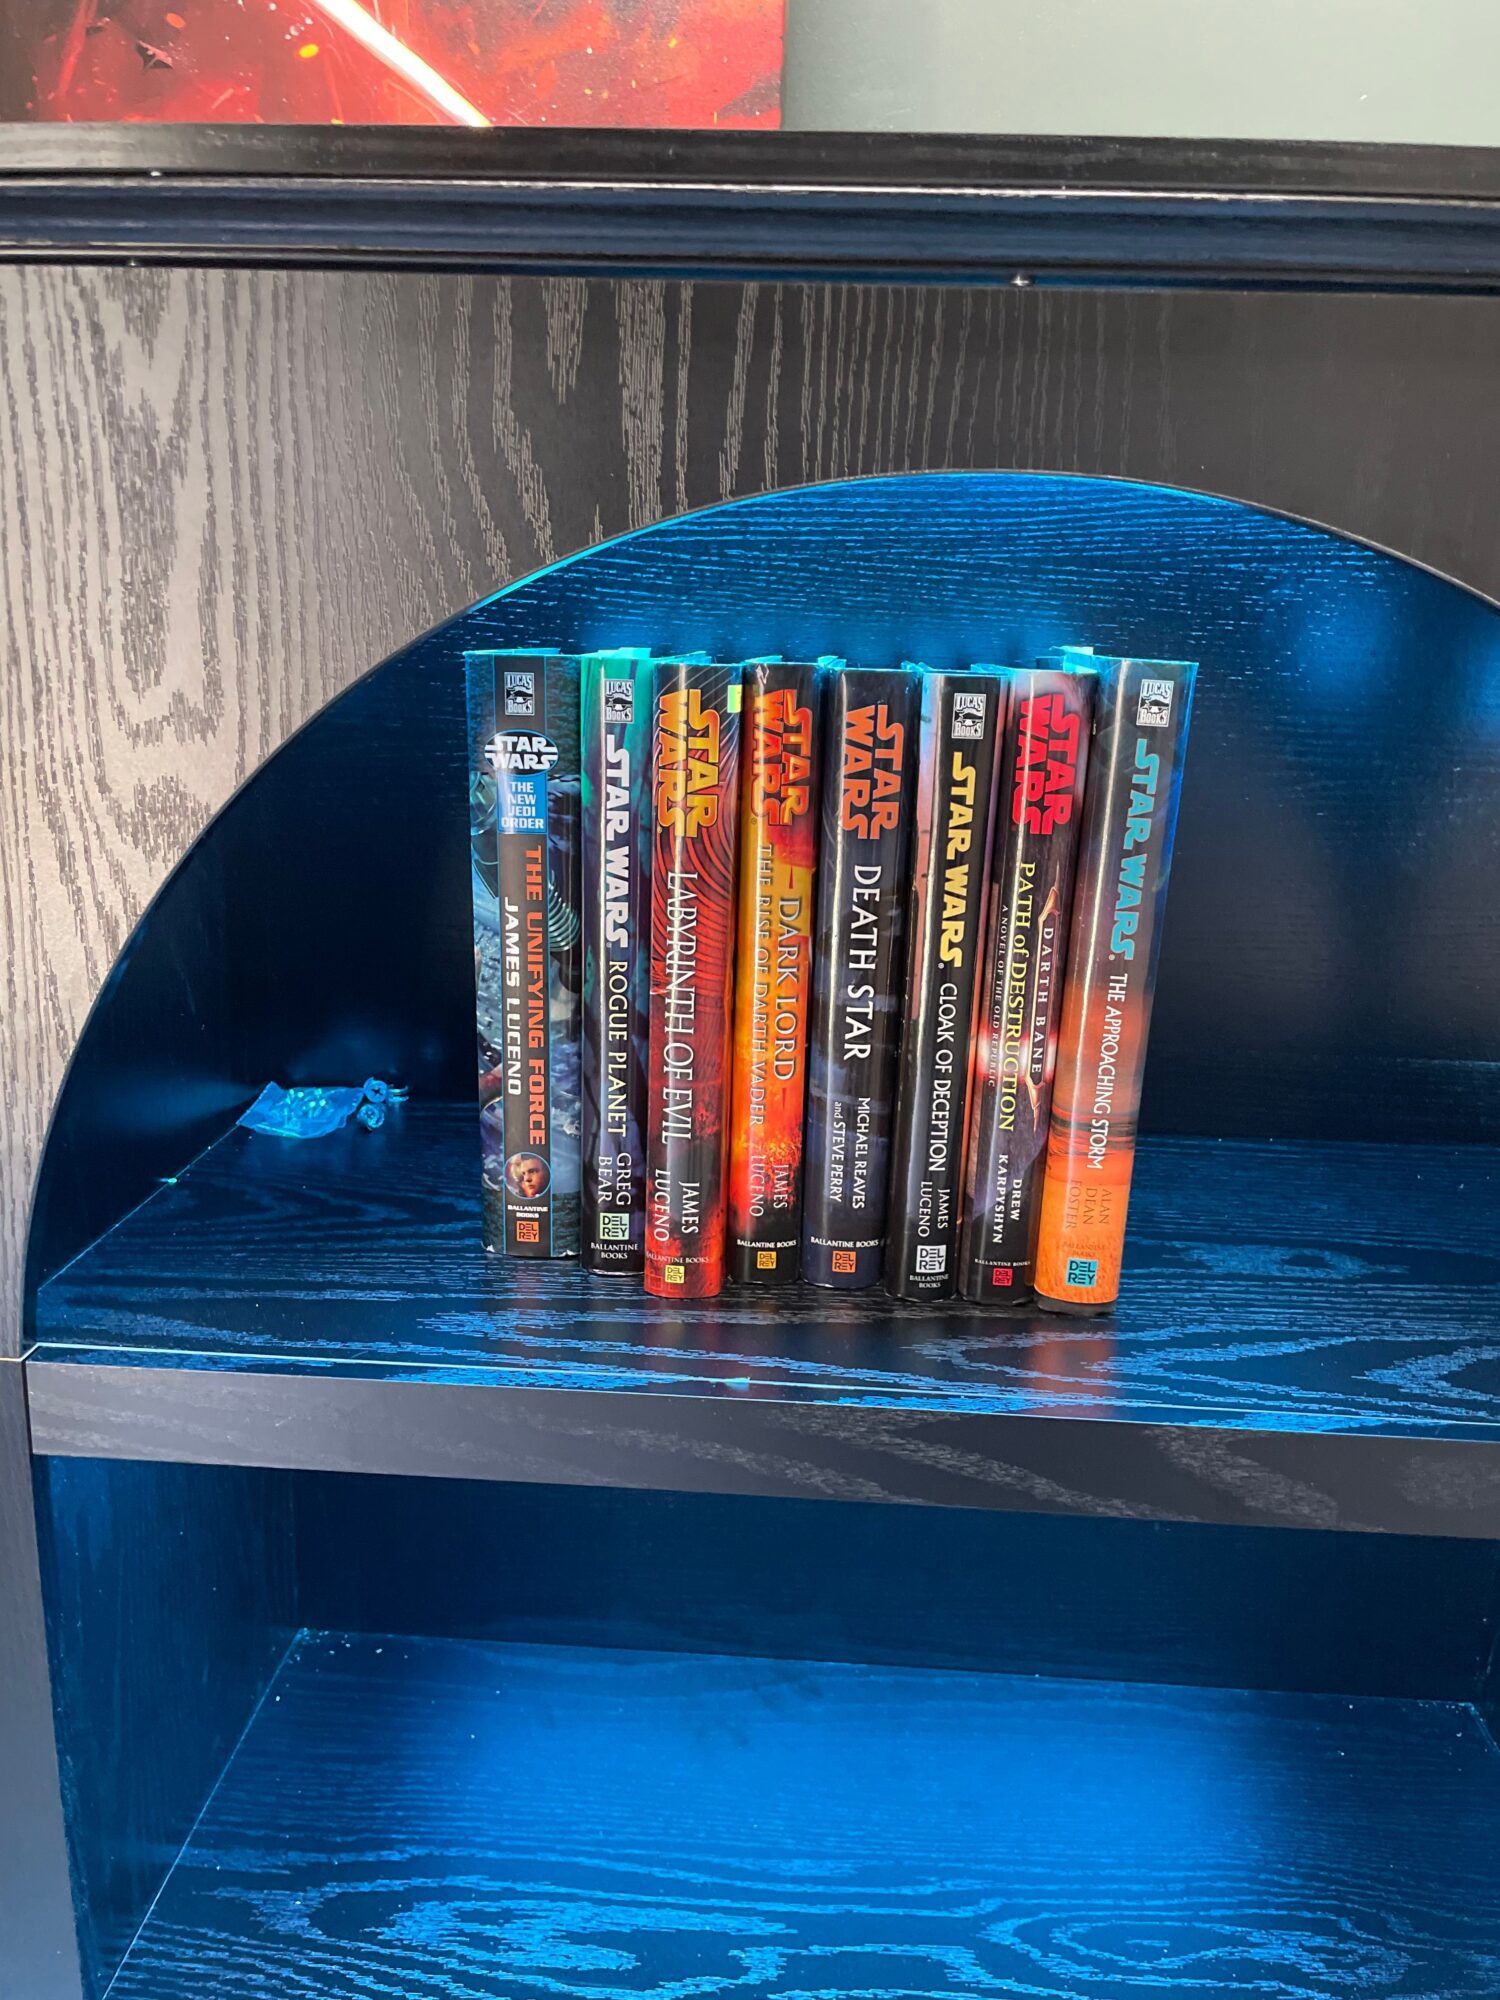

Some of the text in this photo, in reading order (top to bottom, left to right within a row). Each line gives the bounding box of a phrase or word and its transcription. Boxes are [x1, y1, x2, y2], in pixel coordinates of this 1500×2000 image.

[507, 674, 532, 690] LUCAS
[606, 680, 632, 695] LUCAS
[1142, 682, 1171, 698] LUCAS
[507, 702, 533, 713] BOOKS
[606, 707, 632, 720] BOOKS
[956, 695, 983, 711] LUCAS
[1140, 708, 1168, 724] BOOKS
[484, 736, 558, 752] STAR
[954, 722, 982, 737] BOOKS
[484, 752, 558, 770] WARS
[658, 689, 689, 836] WARS
[686, 689, 720, 837] STAR
[752, 689, 784, 825] WARS
[780, 689, 813, 825] STAR
[840, 705, 875, 839] WARS
[870, 705, 904, 839] STAR
[1012, 695, 1053, 835] WARS
[1042, 695, 1080, 835] STAR
[508, 794, 536, 804] NEW
[511, 781, 534, 792] THE
[501, 818, 544, 829] ORDER
[508, 806, 536, 817] JEDI
[605, 735, 630, 1137] STAR WARS ROGUE PLANET
[1087, 739, 1160, 1169] STAR WARS THE APPROACHING STORM
[843, 865, 882, 1061] DEATH STAR
[929, 752, 976, 1171] STAR WARS CLOAK OF DECEPTION
[505, 897, 522, 1095] JAMES LUCENO
[526, 845, 546, 1145] THE UNIFYING FORCE
[751, 844, 774, 1127] THE RISE OF DARTH VADER
[773, 897, 802, 1081] DARK LORD
[988, 904, 1008, 1087] A NOVEL OF THE OLD REPUBLIC
[999, 862, 1036, 1131] PATH of DESTRUCTION
[1031, 927, 1054, 1073] DARTH BANE
[662, 872, 698, 1144] LABYRINTH OF EVIL
[829, 1101, 846, 1203] and STEVE PERRY
[852, 1097, 871, 1209] MICHAEL REAVES
[598, 1156, 612, 1204] BEAR
[616, 1152, 632, 1205] GREG
[750, 1154, 766, 1217] LUCENO
[773, 1164, 789, 1209] JAMES
[507, 1204, 549, 1212] BALLANTINE
[653, 1169, 671, 1241] LUCENO
[678, 1182, 700, 1234] JAMES
[918, 1181, 933, 1238] LUCENO
[937, 1189, 950, 1229] JAMES
[992, 1154, 1008, 1243] KARPYSHYN
[1010, 1179, 1022, 1221] DREW
[1065, 1180, 1082, 1229] FOSTER
[1083, 1188, 1098, 1225] DEAN
[1099, 1188, 1112, 1224] ALAN
[518, 1222, 537, 1231] DEL
[518, 1231, 538, 1240] REY
[602, 1215, 627, 1226] DEL
[602, 1227, 628, 1238] REY
[591, 1242, 638, 1251] BALLANTINE
[645, 1252, 684, 1263] BALLANTINE
[737, 1239, 797, 1248] BALLANTINE BOOKS
[811, 1237, 854, 1247] BALLANTINE
[835, 1253, 854, 1261] DEL
[919, 1248, 944, 1259] DEL
[666, 1274, 683, 1282] REY
[667, 1266, 683, 1274] DEL
[834, 1262, 855, 1270] REY
[919, 1260, 945, 1271] REY
[1067, 1273, 1096, 1285] REY
[1069, 1260, 1096, 1272] DEL
